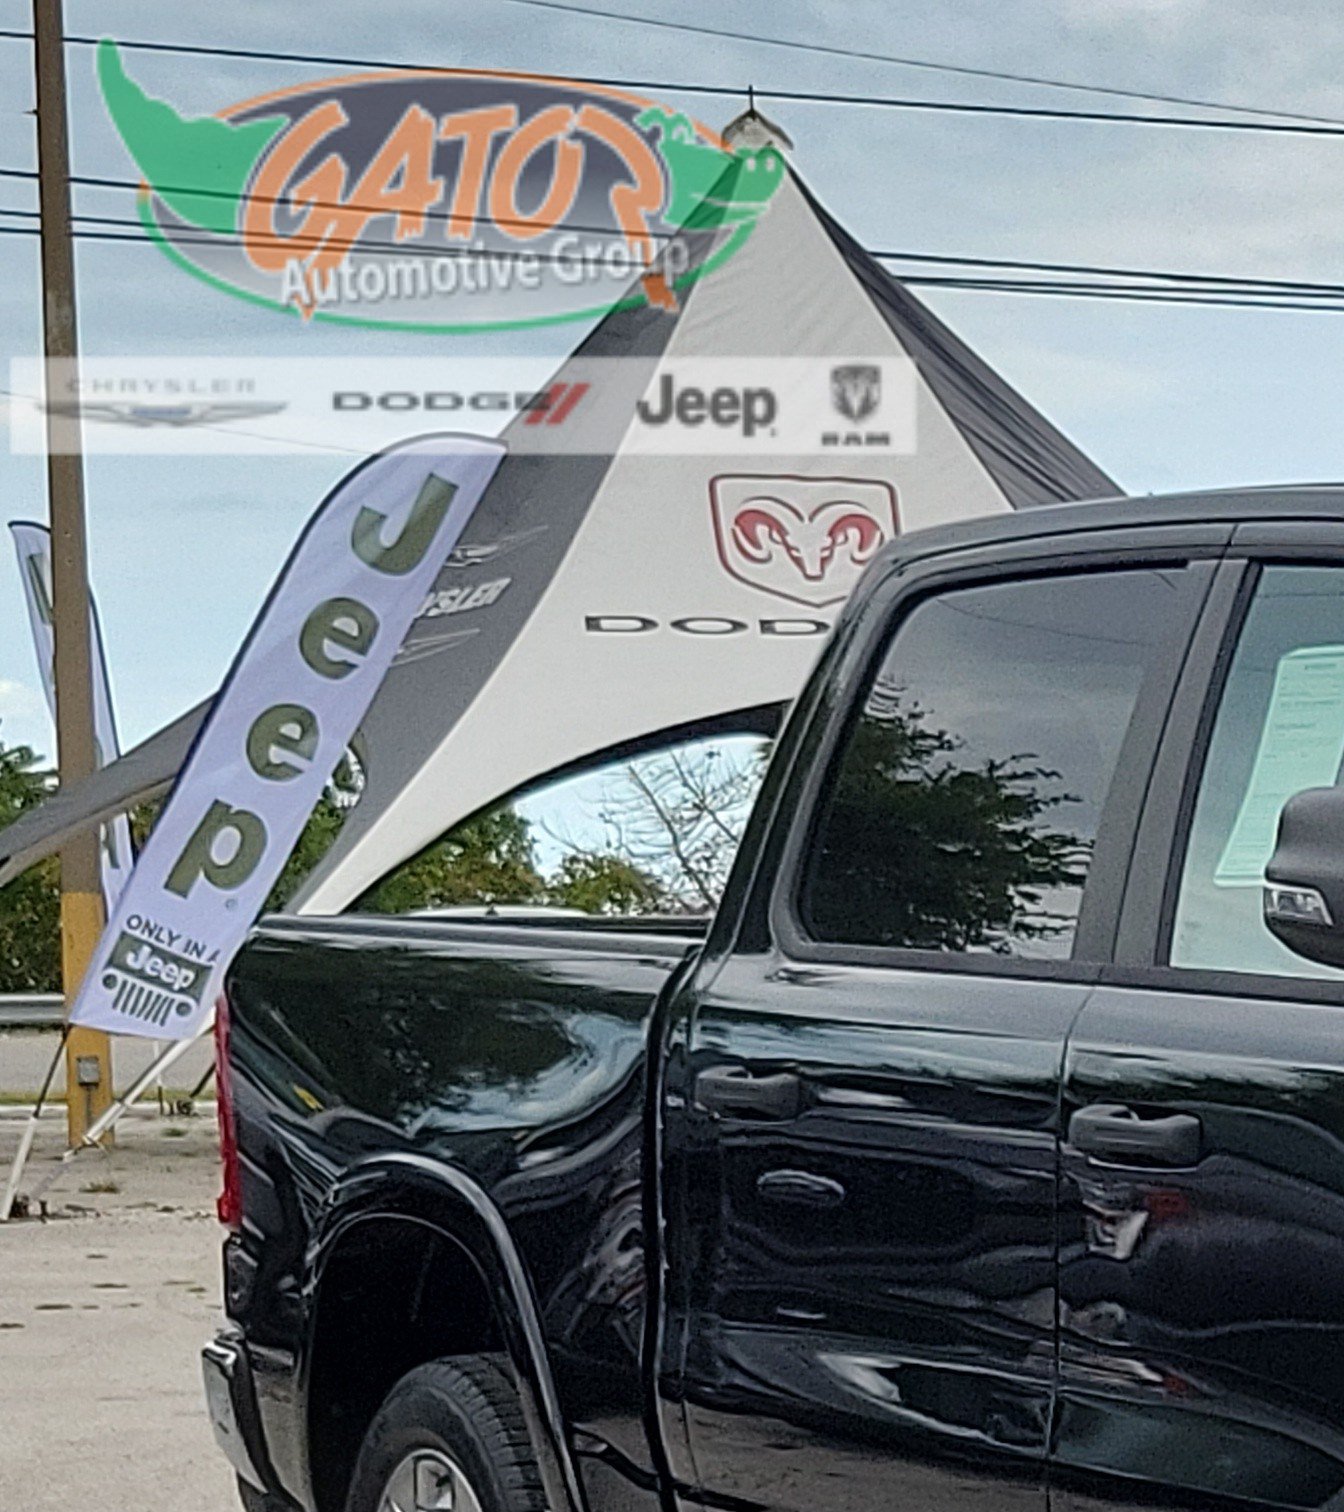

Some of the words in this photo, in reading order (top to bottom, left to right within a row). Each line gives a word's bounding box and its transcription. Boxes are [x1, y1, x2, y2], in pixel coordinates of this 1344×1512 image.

[163, 472, 458, 899] Jeep
[126, 914, 181, 947] ONLY
[182, 939, 207, 958] IN
[126, 944, 197, 990] Jeep
